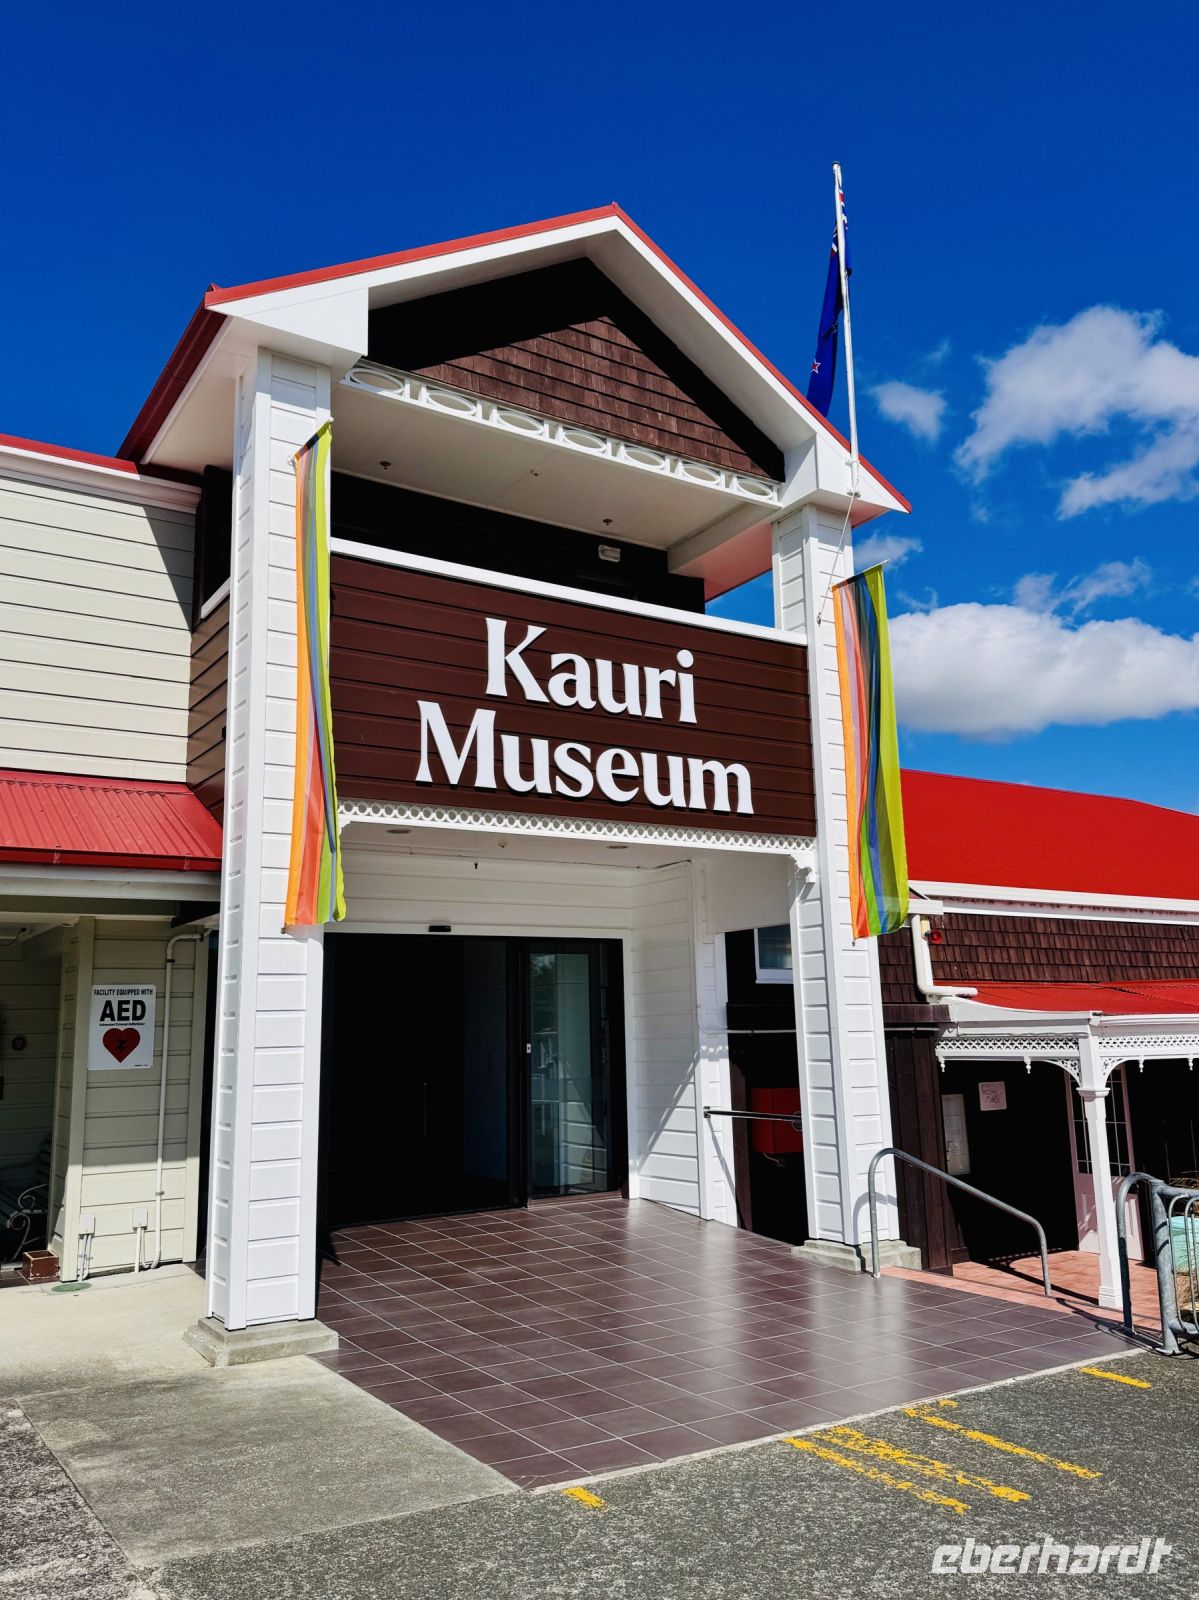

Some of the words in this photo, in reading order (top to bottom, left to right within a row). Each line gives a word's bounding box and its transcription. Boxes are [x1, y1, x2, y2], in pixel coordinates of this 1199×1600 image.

[485, 617, 697, 723] Kauri
[415, 700, 754, 815] Museum
[99, 999, 146, 1021] AED
[140, 988, 153, 996] WITH
